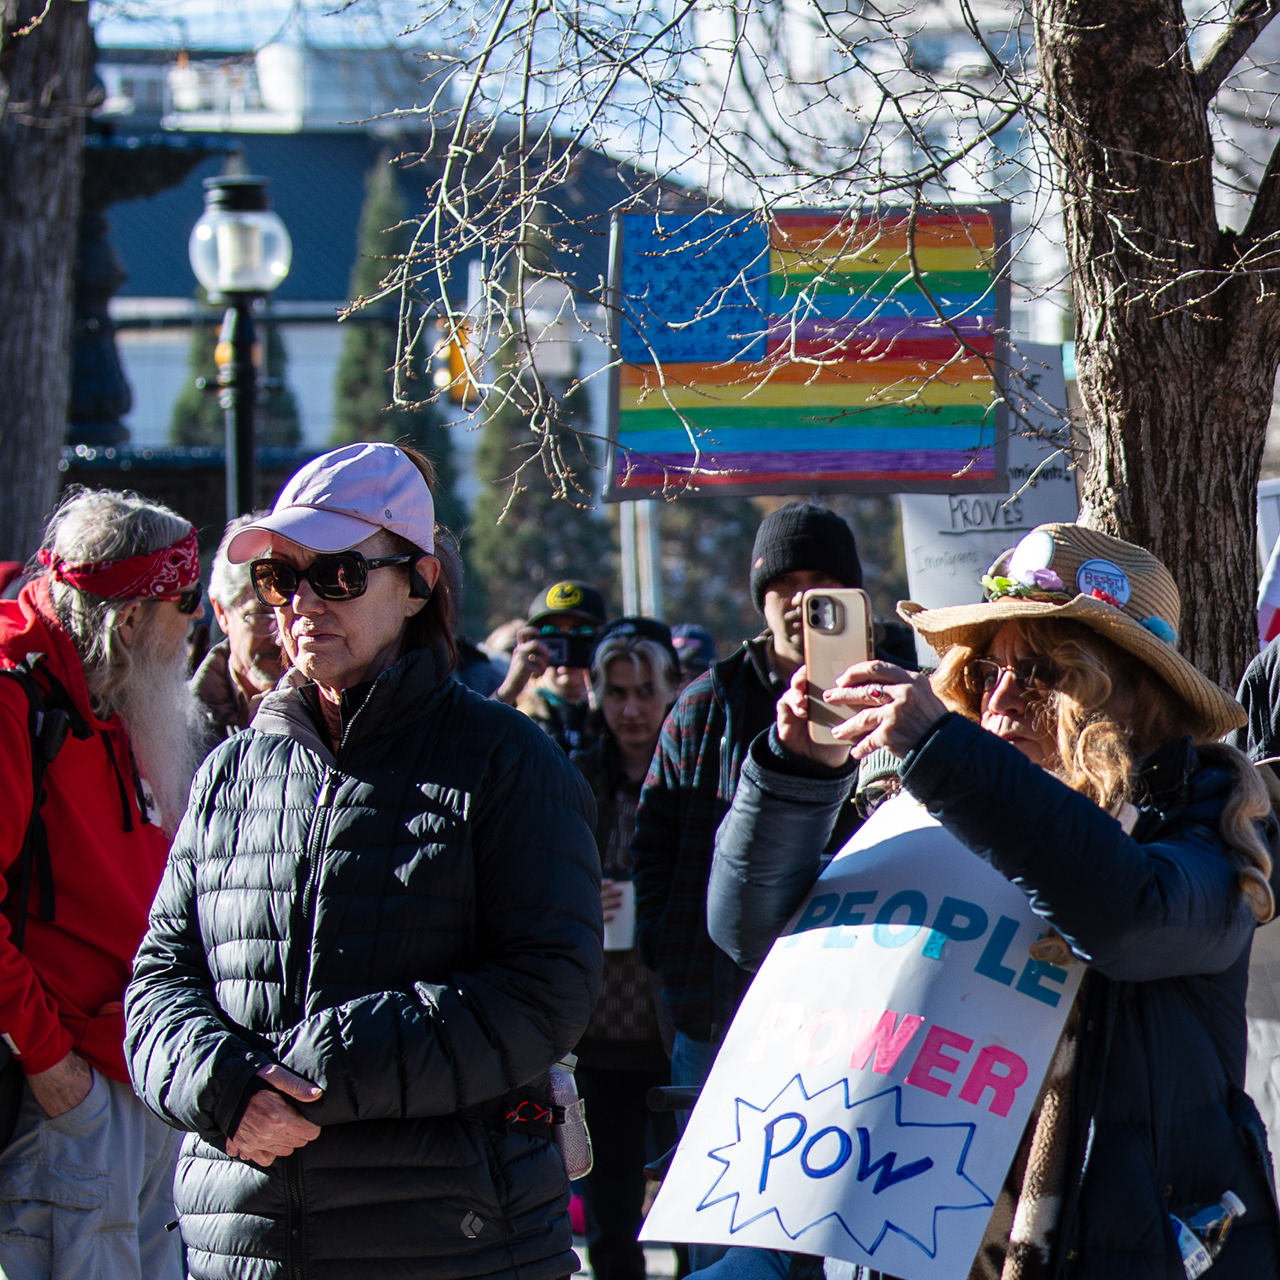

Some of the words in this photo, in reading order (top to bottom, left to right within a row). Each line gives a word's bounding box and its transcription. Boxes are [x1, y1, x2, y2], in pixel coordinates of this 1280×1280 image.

[950, 494, 1023, 529] PROVES
[784, 889, 1069, 1008] PEOPLE
[746, 1006, 1029, 1118] POWER
[758, 1112, 933, 1195] POW
